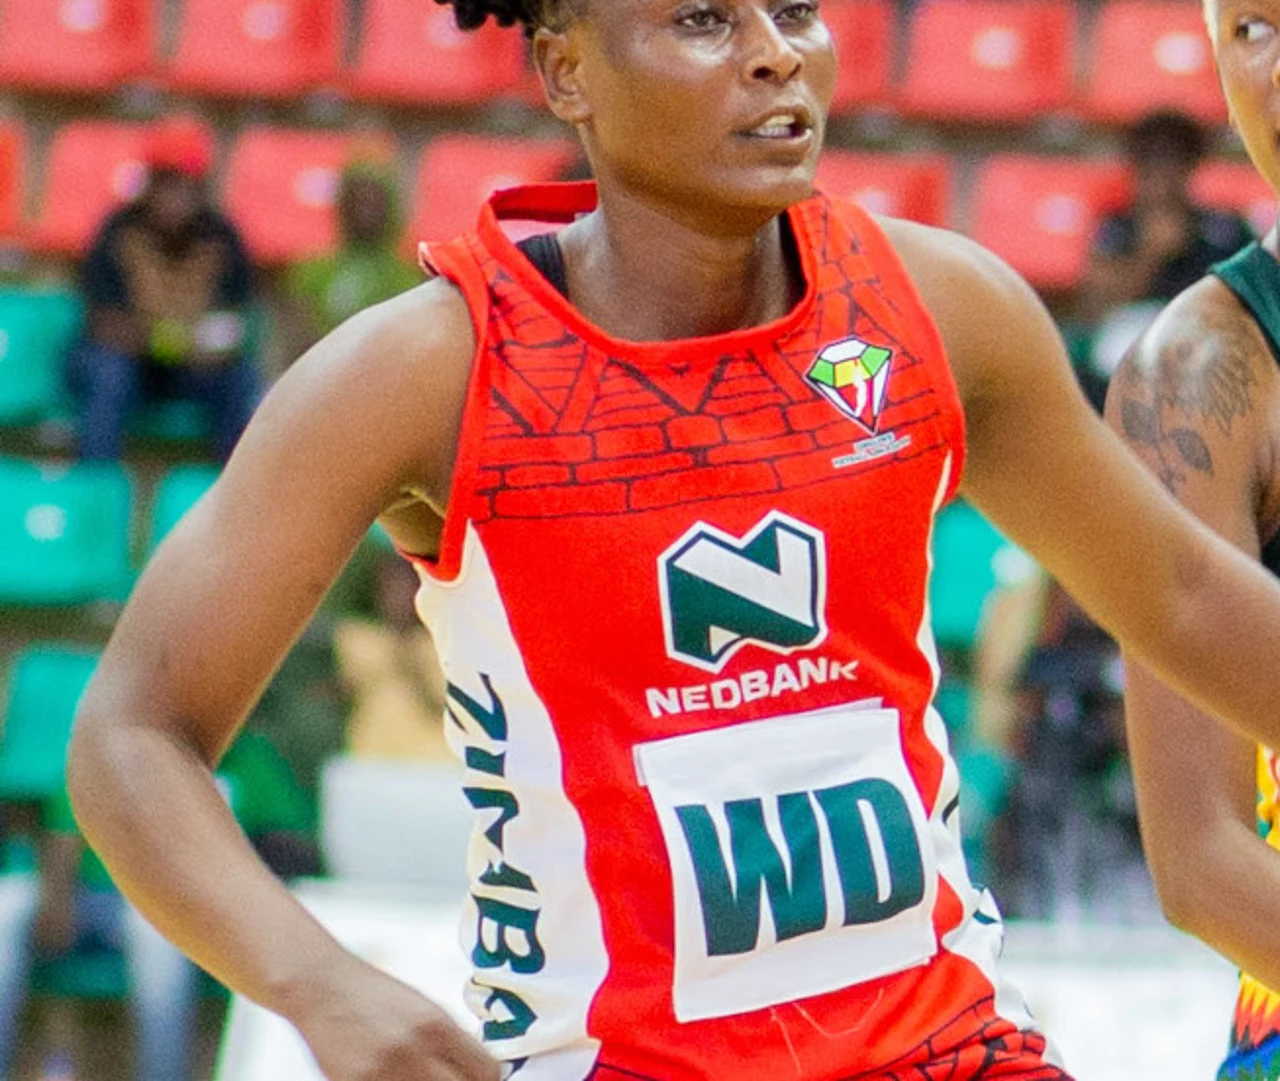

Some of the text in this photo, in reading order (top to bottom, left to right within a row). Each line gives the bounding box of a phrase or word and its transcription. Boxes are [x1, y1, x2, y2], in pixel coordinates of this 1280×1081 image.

[645, 657, 860, 718] NEDBANK
[445, 672, 546, 1081] ZIMBA
[674, 776, 926, 958] WD
